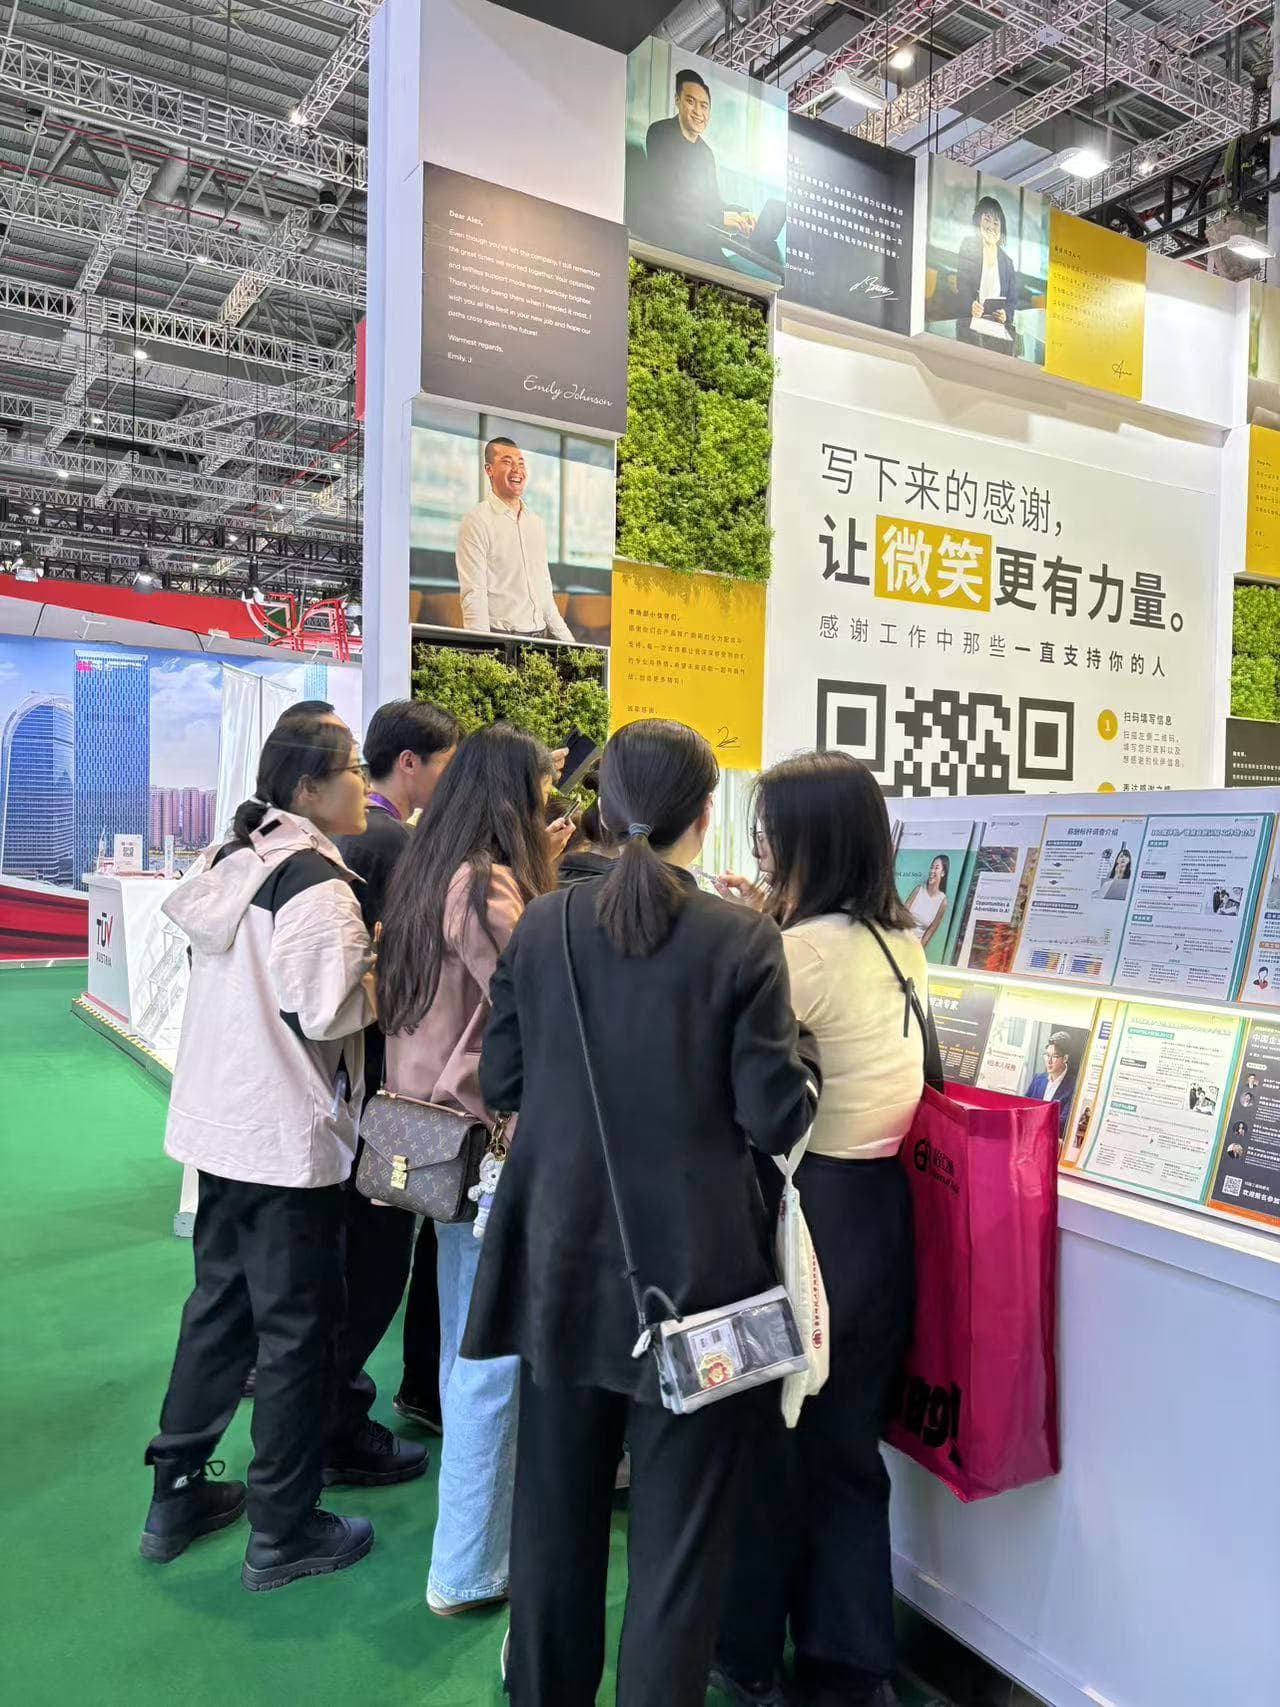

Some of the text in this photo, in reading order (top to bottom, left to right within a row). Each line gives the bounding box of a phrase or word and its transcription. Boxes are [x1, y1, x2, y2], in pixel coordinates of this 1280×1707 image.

[449, 210, 483, 226] Dear Alex,
[448, 229, 465, 239] Even
[465, 234, 487, 246] though
[509, 246, 519, 255] left
[573, 265, 600, 278] remember
[448, 245, 459, 254] the
[460, 249, 477, 259] great
[496, 259, 504, 267] we
[505, 262, 527, 273] worked
[568, 279, 595, 292] optimism
[448, 262, 460, 270] and
[484, 271, 508, 283] support
[508, 277, 526, 288] made
[527, 283, 542, 293] every
[543, 287, 568, 300] workday
[449, 277, 467, 288] Thank
[468, 283, 480, 291] you
[481, 285, 490, 294] for
[490, 289, 508, 300] being
[509, 293, 525, 303] there
[526, 298, 541, 307] when
[546, 303, 567, 314] needed
[448, 294, 463, 303] wish
[464, 298, 475, 307] you
[484, 303, 495, 311] the
[495, 304, 509, 314] best
[516, 312, 530, 320] your
[543, 318, 553, 326] job
[554, 320, 566, 329] and
[566, 323, 581, 333] hope
[448, 310, 466, 320] paths
[466, 315, 483, 324] cross
[483, 319, 500, 328] again
[508, 323, 518, 332] the
[518, 327, 538, 337] future!
[448, 333, 504, 352] Warmest regards,
[523, 374, 613, 407] Emily Johnson
[821, 442, 1064, 538] 写下来的感谢，
[817, 513, 1184, 634] 让微笑更有力量。
[818, 614, 1167, 679] 感谢工作中那些一直支持你的人
[1123, 712, 1172, 726] 扫码填写信息
[96, 911, 113, 948] TÜV
